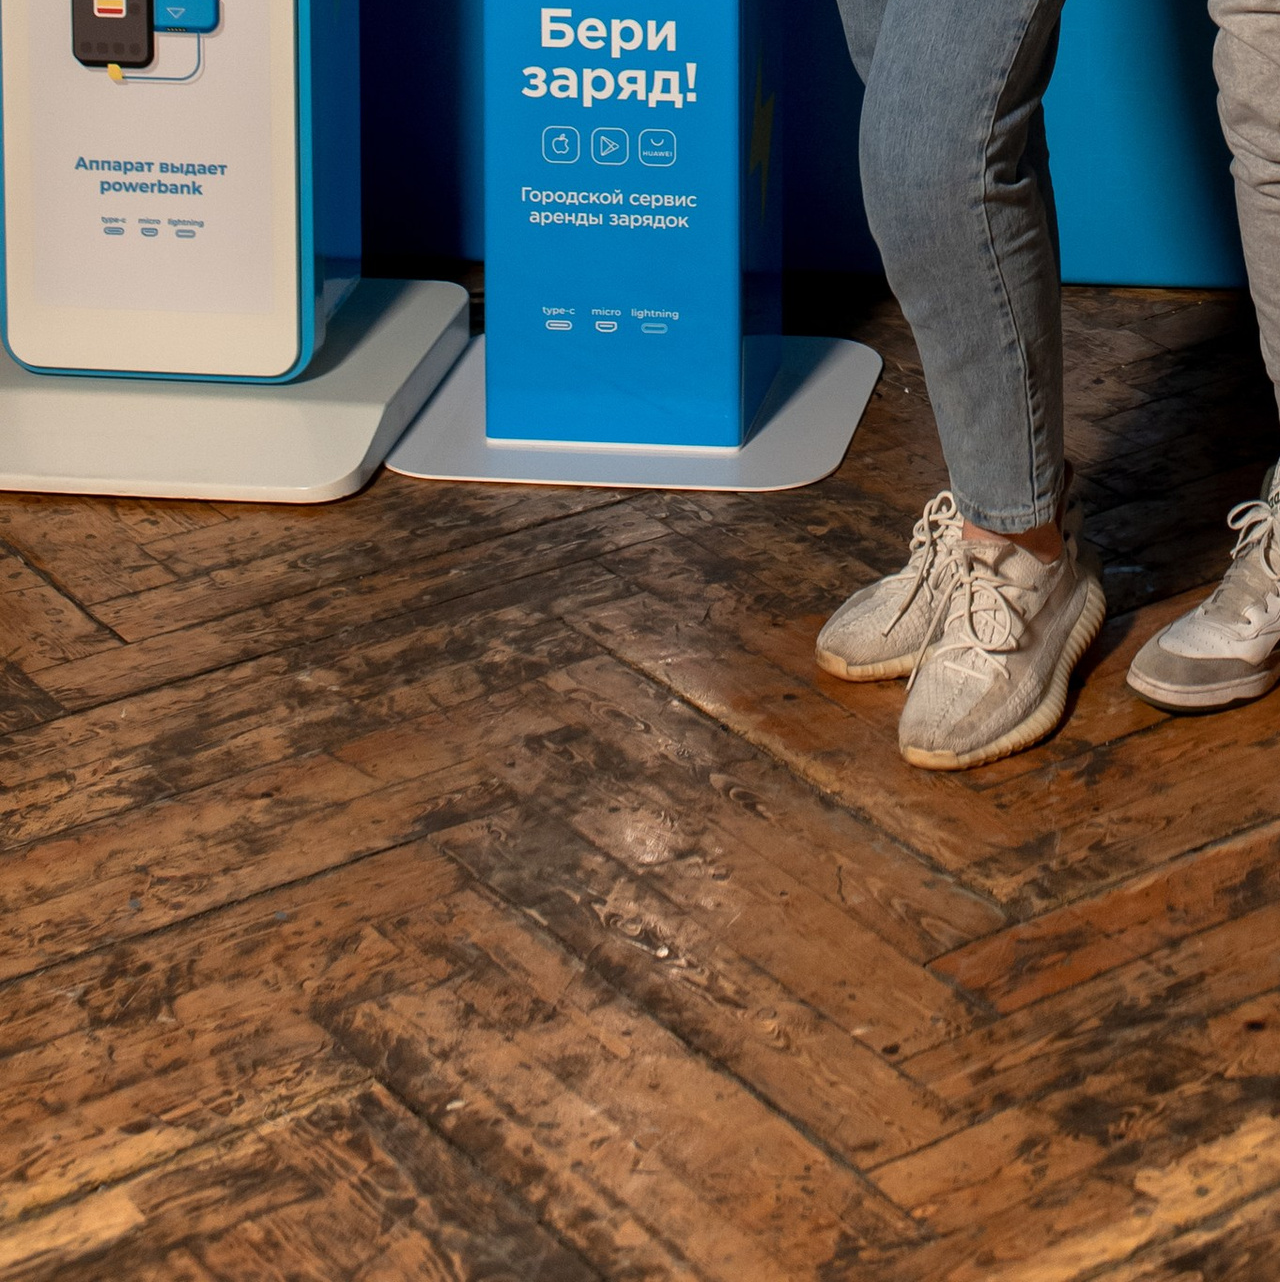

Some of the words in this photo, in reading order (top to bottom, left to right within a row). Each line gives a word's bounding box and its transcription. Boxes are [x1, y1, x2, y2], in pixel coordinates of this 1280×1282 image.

[540, 6, 677, 59] Бери
[521, 62, 698, 109] заряд!
[642, 150, 674, 158] HUAWEI
[74, 155, 155, 174] Аппарат
[159, 160, 228, 178] выдает
[99, 178, 203, 196] powerbank
[520, 186, 624, 207] Городской
[628, 191, 698, 210] сервис
[101, 215, 127, 225] type-c
[137, 217, 161, 225] micro
[167, 217, 205, 228] lightning
[528, 209, 603, 227] аренды
[608, 213, 690, 231] зарядок
[542, 306, 576, 317] type-c
[591, 307, 622, 316] micro
[630, 308, 680, 321] lightning
